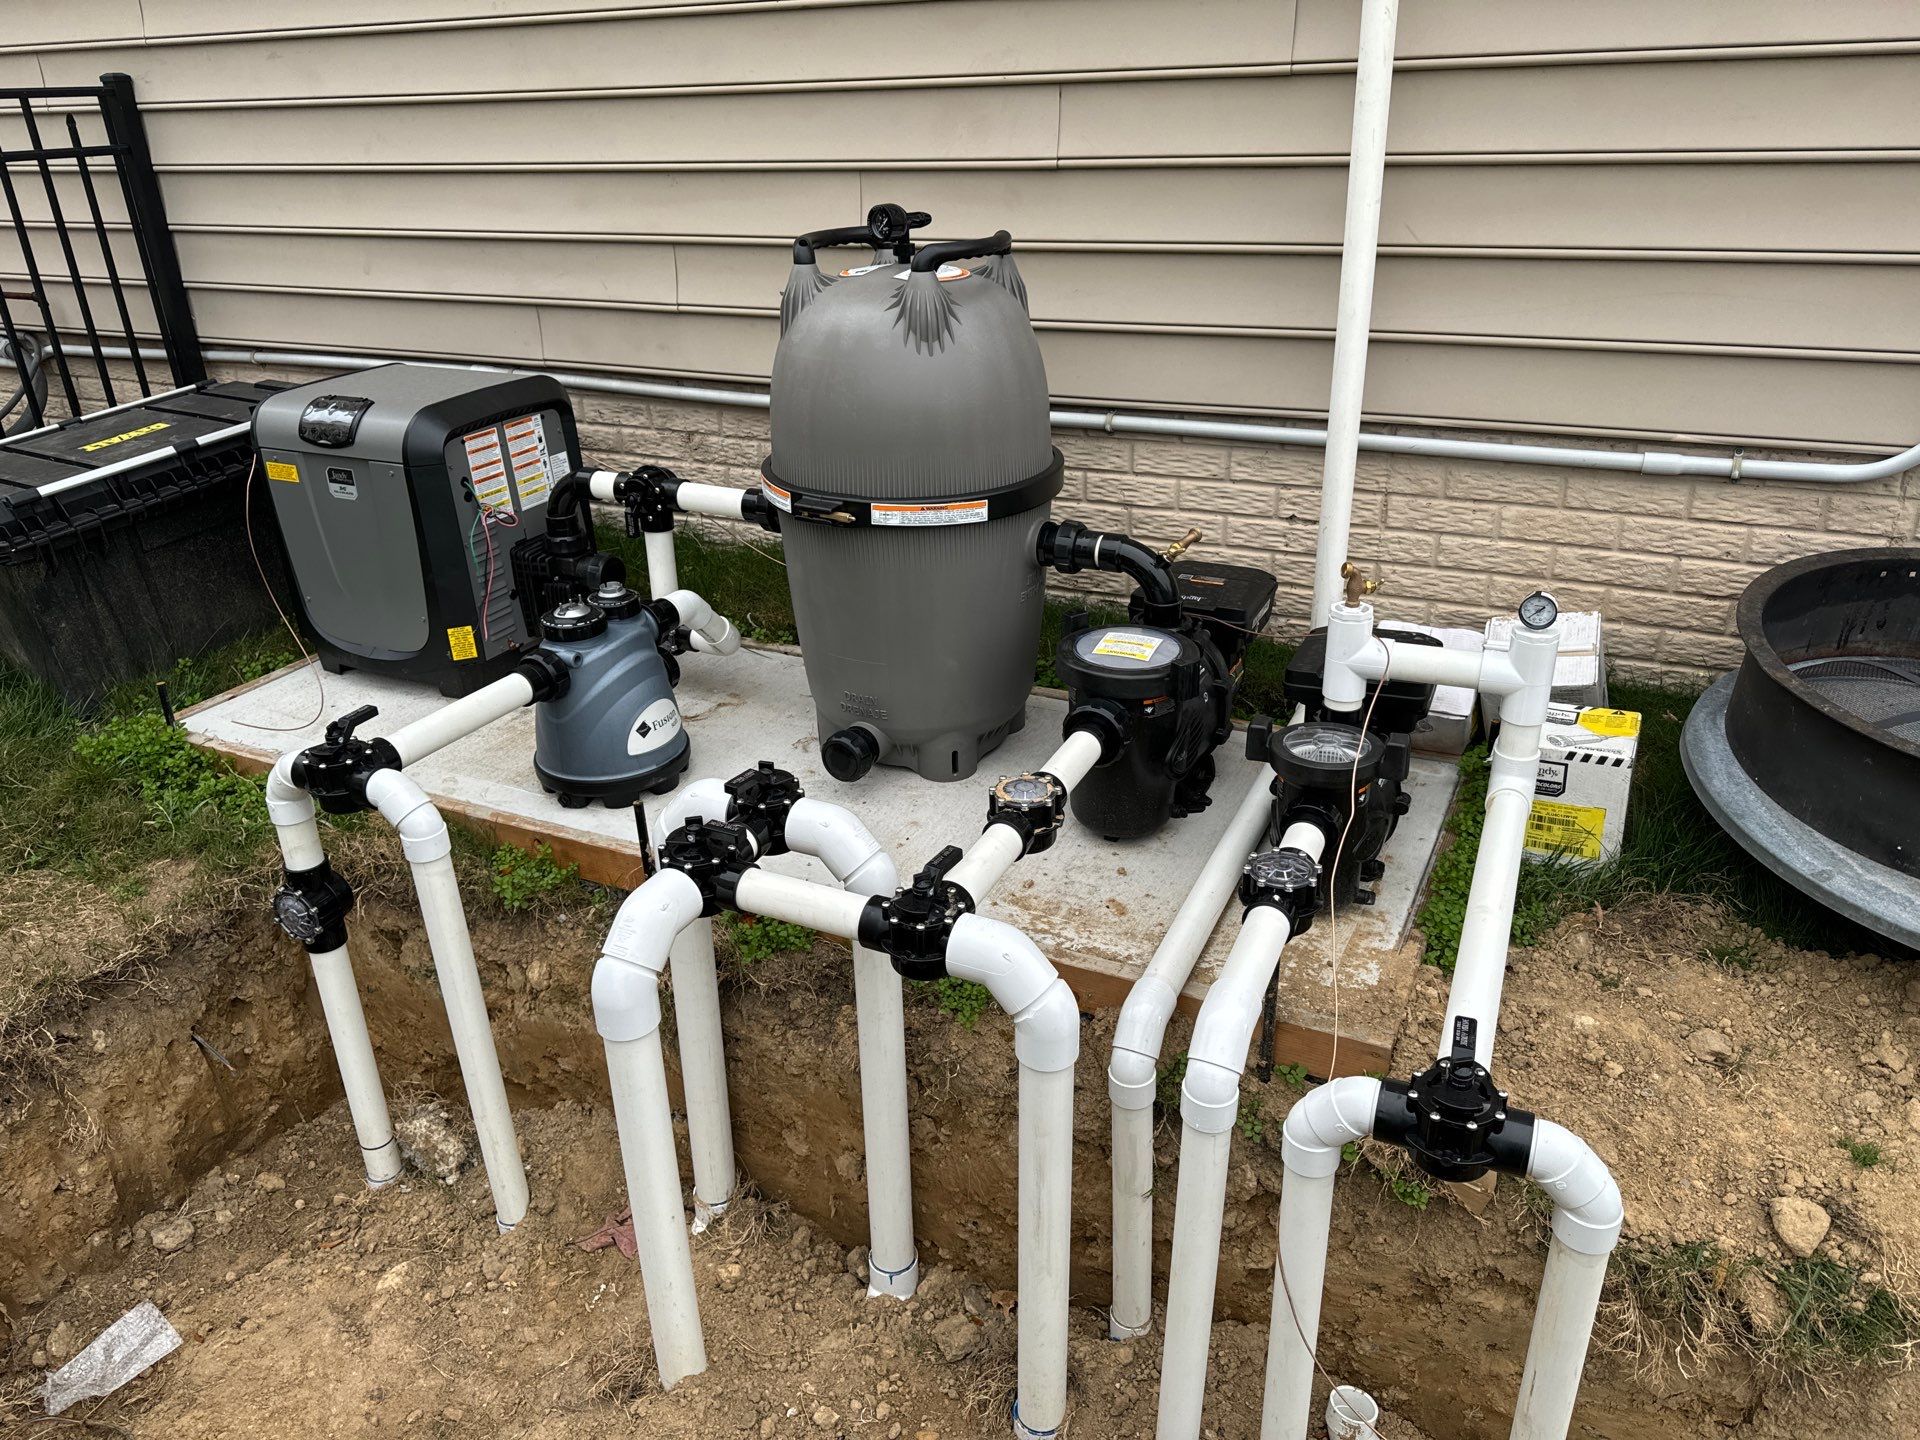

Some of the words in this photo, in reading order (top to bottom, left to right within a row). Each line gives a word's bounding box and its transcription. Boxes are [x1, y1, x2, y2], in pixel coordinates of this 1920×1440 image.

[844, 690, 878, 706] DRAIN
[652, 709, 676, 731] Fusion
[1538, 767, 1557, 777] ndy
